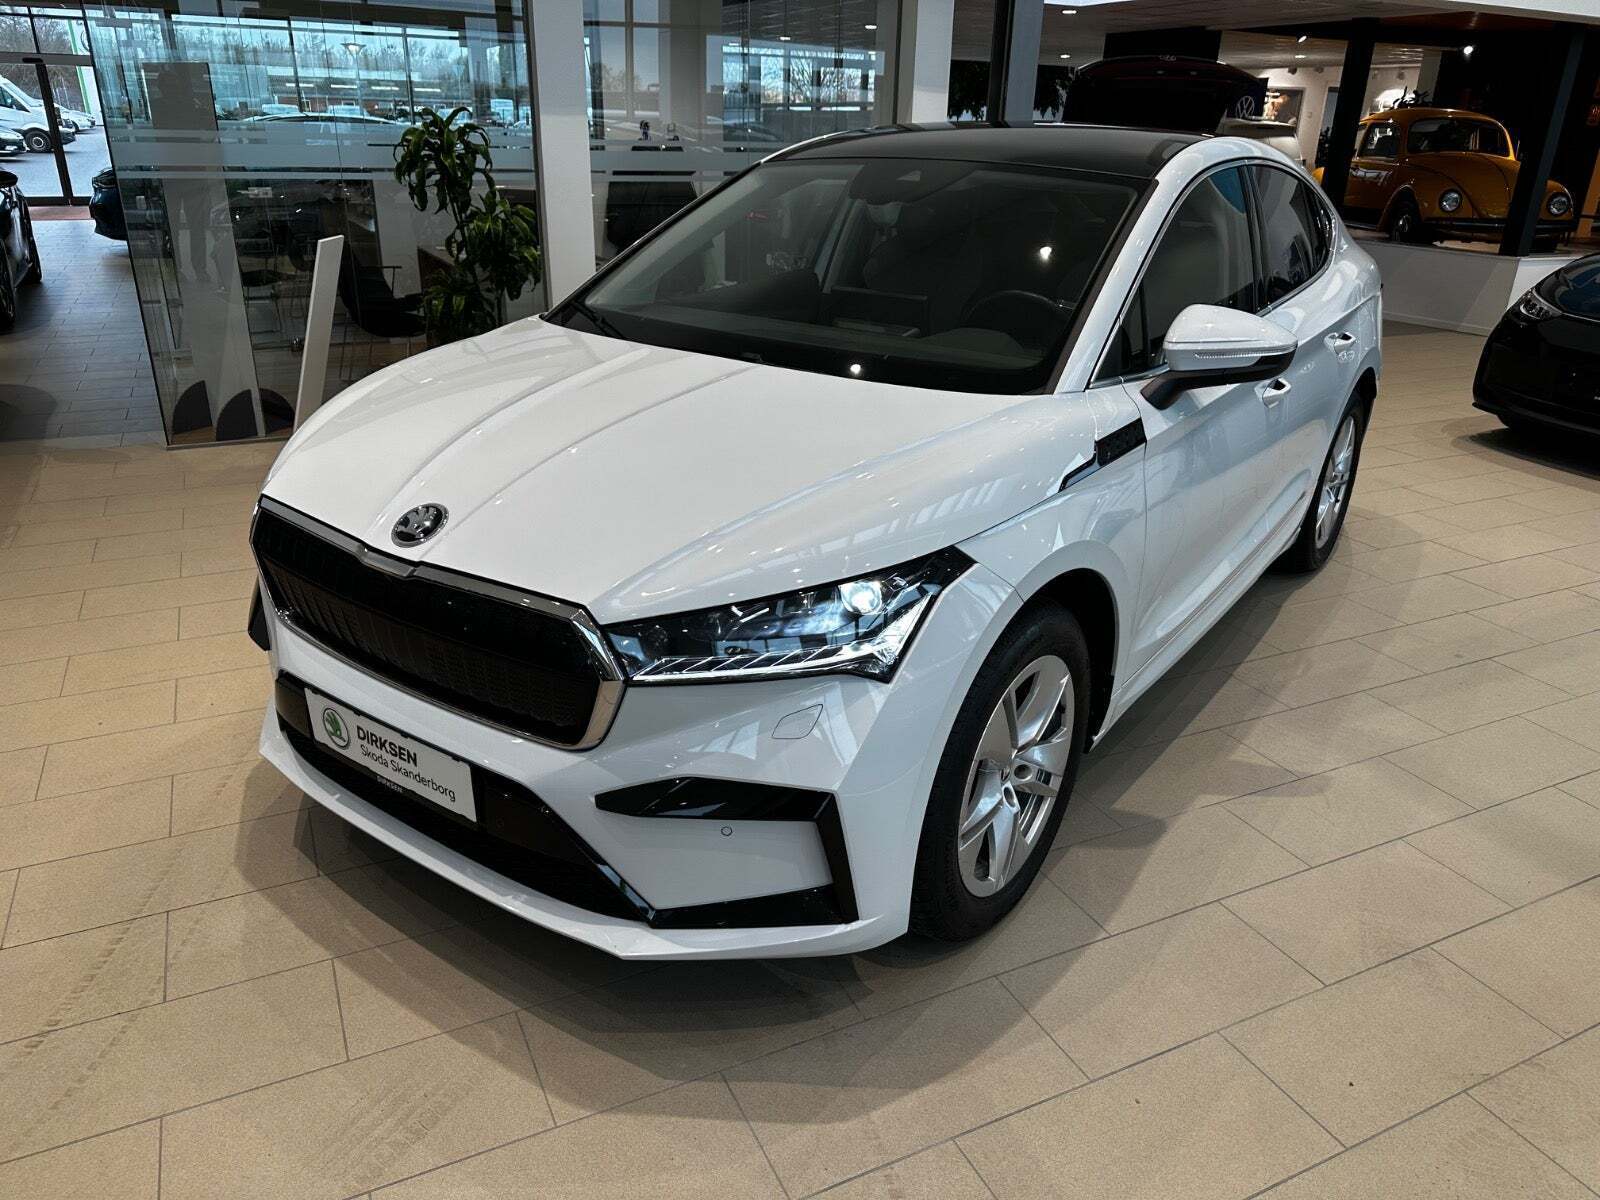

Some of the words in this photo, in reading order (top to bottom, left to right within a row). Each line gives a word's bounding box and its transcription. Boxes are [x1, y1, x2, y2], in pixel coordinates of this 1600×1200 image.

[357, 725, 417, 767] DIRKSEN
[360, 744, 389, 767] Skoda
[390, 760, 456, 802] Skanderborg
